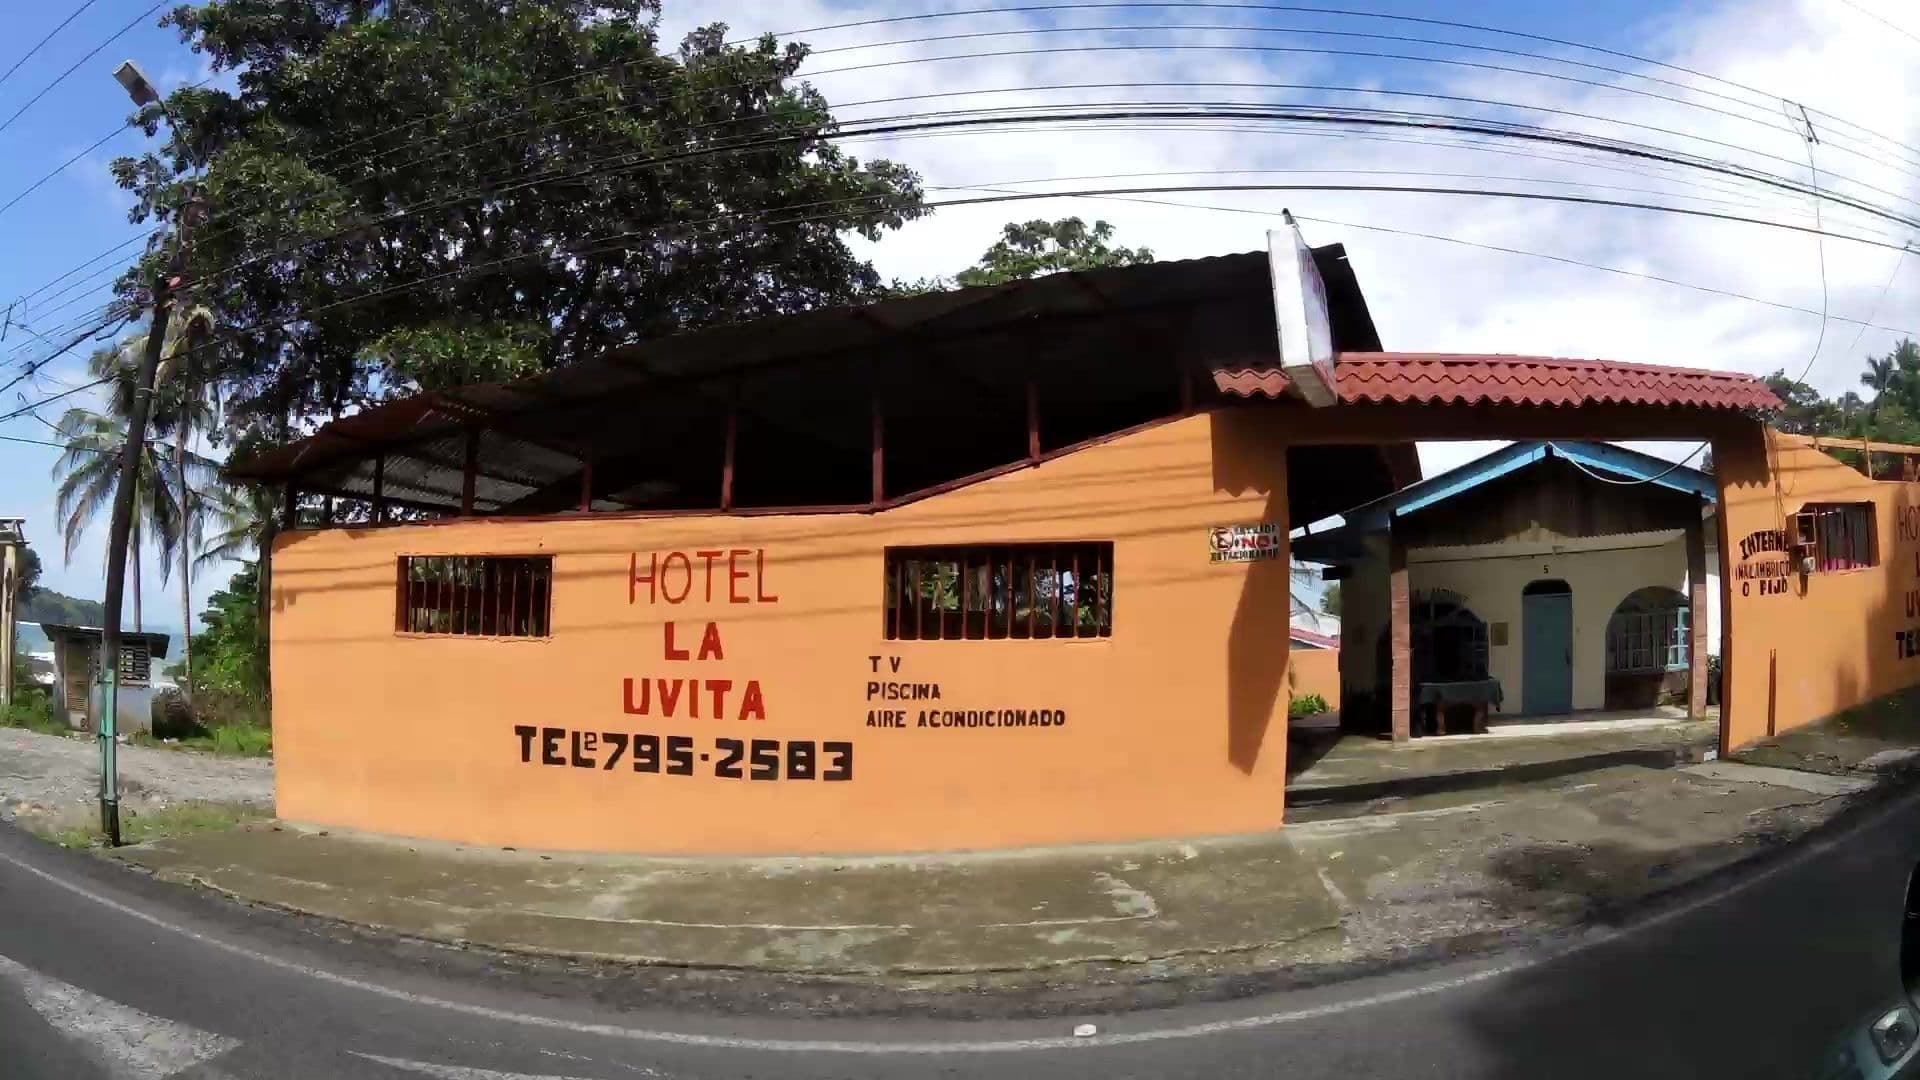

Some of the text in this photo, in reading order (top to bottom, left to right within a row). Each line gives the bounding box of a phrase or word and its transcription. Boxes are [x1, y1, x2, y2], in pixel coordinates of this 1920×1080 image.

[628, 548, 779, 605] HOTEL
[1543, 564, 1550, 574] 5
[1742, 577, 1788, 597] O FIJO
[664, 621, 724, 661] LA
[623, 678, 766, 720] UVITA
[867, 682, 941, 701] PISCINA
[866, 709, 1066, 728] AIRE ACONDICIONADO
